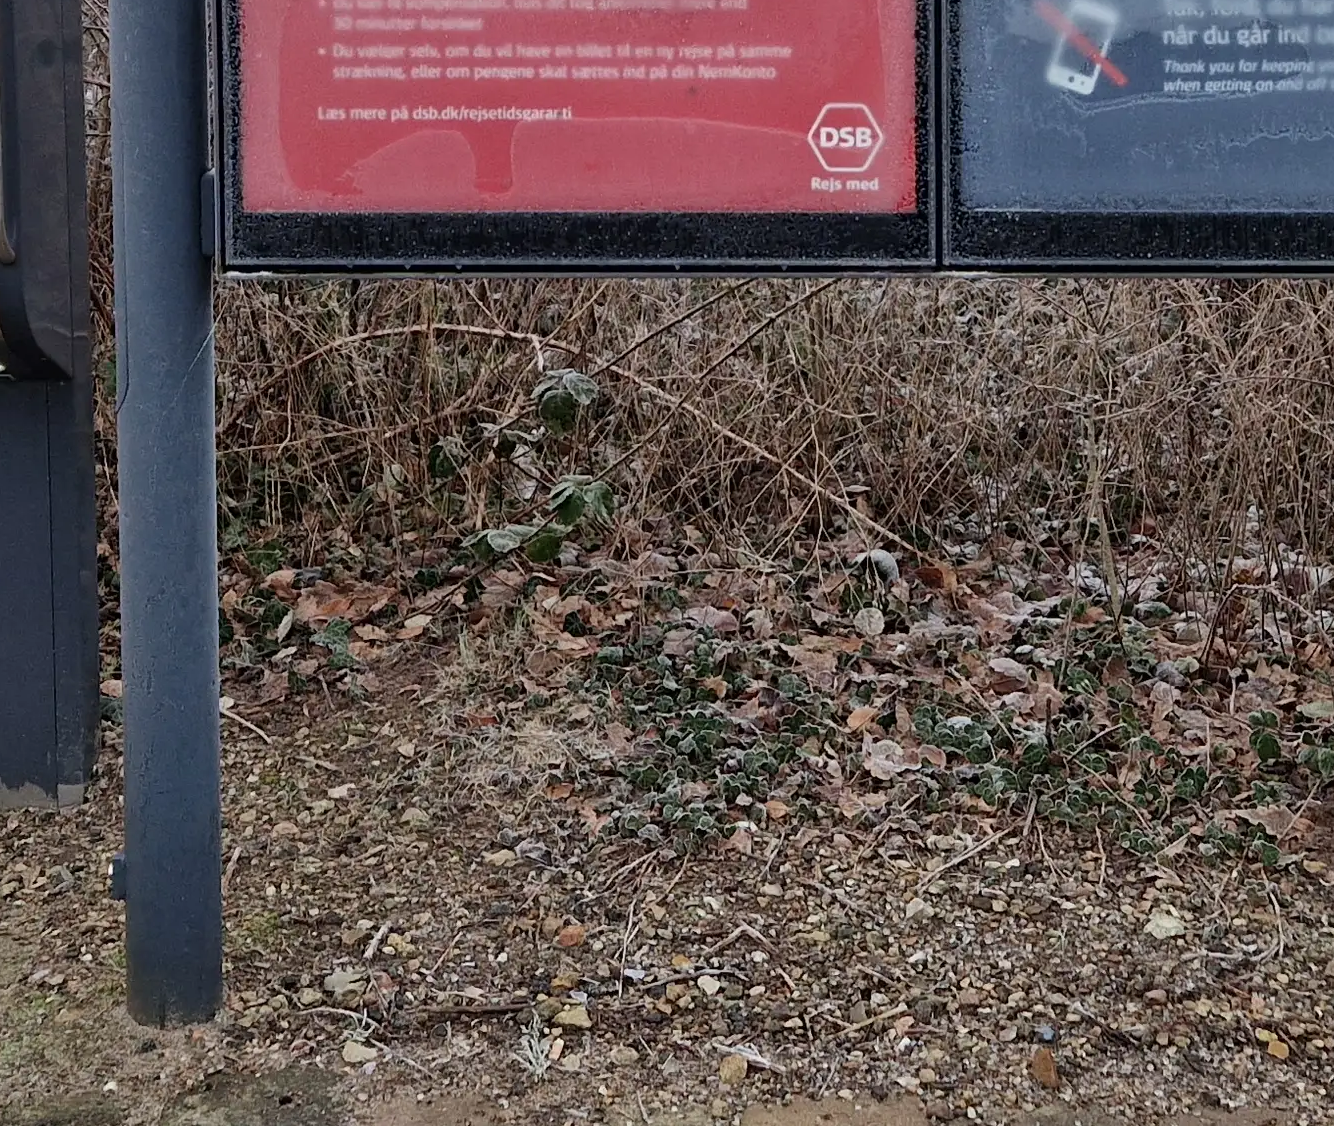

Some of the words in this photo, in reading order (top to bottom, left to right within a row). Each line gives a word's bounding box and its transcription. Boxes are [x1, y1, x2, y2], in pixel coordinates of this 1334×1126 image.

[1162, 24, 1198, 45] når
[1203, 25, 1230, 45] du
[1236, 21, 1270, 47] går
[1277, 25, 1309, 45] ind
[1163, 59, 1205, 74] Thank
[1209, 61, 1234, 76] you
[1238, 59, 1257, 73] for
[1163, 78, 1201, 92] when
[1204, 78, 1252, 93] getting
[1255, 79, 1273, 91] on
[317, 107, 346, 121] Læs
[350, 109, 386, 121] mere
[390, 105, 408, 123] på
[820, 126, 872, 147] DSB
[811, 177, 842, 192] Rejs
[846, 177, 879, 190] med
